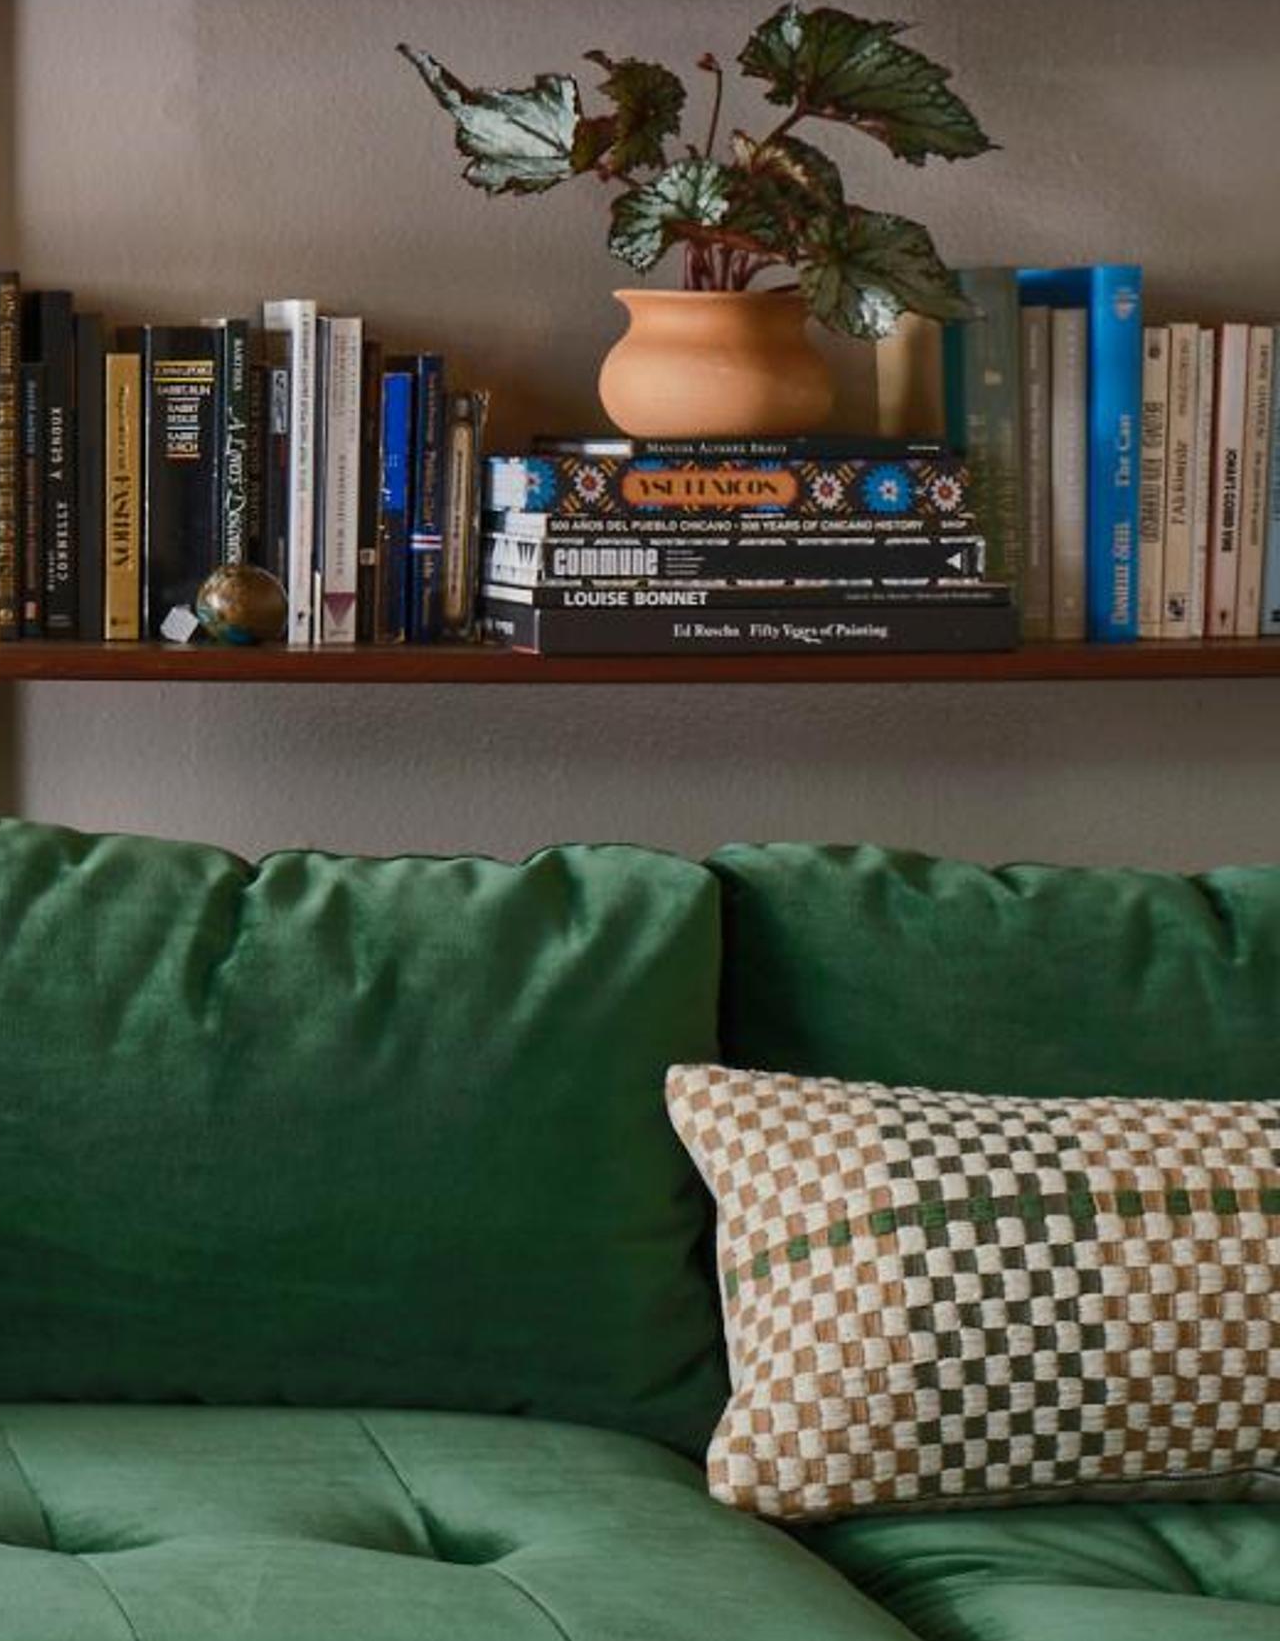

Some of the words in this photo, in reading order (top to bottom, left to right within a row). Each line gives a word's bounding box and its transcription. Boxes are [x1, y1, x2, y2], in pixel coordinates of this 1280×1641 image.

[50, 406, 64, 463] GENOUX
[639, 479, 672, 496] YSL
[684, 479, 779, 496] LEXICON
[550, 519, 570, 532] 500
[571, 517, 604, 532] AÑOS
[606, 519, 629, 532] DEL
[632, 519, 676, 532] PUEBLO
[679, 519, 733, 532] CHICANO
[762, 520, 801, 532] YEARS
[802, 520, 818, 532] OF
[820, 519, 873, 532] CHICANO
[875, 519, 924, 532] HISTORY
[56, 500, 69, 581] CONNELLY
[553, 547, 659, 576] commune
[563, 591, 629, 605] LOUISE
[633, 591, 709, 605] BONNET
[673, 623, 691, 637] Ed
[693, 623, 740, 638] Ruscha
[750, 623, 780, 639] Fifty
[783, 624, 817, 638] Years
[819, 623, 835, 637] of
[836, 623, 888, 639] Painting
